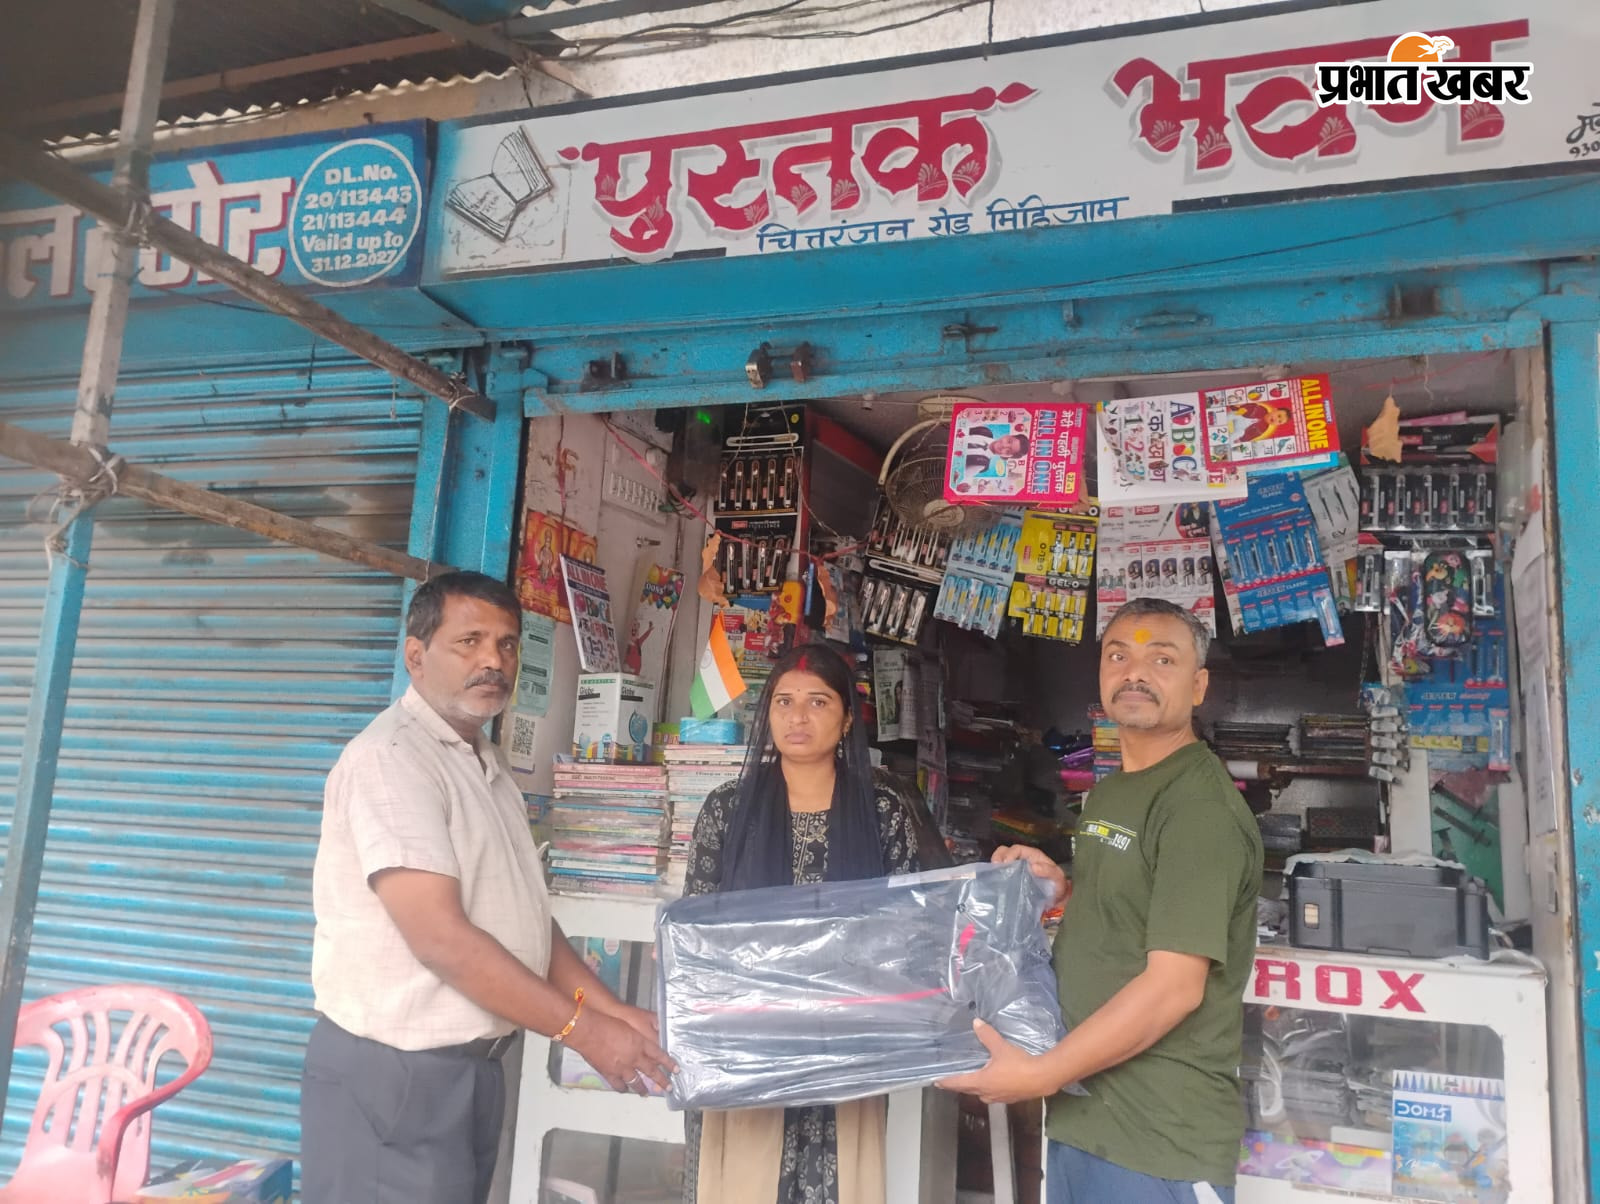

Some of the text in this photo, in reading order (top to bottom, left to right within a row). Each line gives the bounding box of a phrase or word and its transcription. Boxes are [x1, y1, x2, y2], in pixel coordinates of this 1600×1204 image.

[580, 86, 1000, 256] पुस्तक
[302, 206, 407, 231] 21/113444
[756, 219, 915, 252] चित्तरंजन
[928, 206, 974, 236] रोड
[357, 236, 381, 253] up
[383, 231, 404, 248] to
[311, 250, 398, 273] 31.12.2027
[1037, 409, 1058, 437] ALL
[1301, 379, 1329, 451] ALL IN ONE
[1171, 426, 1195, 443] B
[1034, 439, 1054, 457] IN
[1031, 460, 1052, 494] ONE
